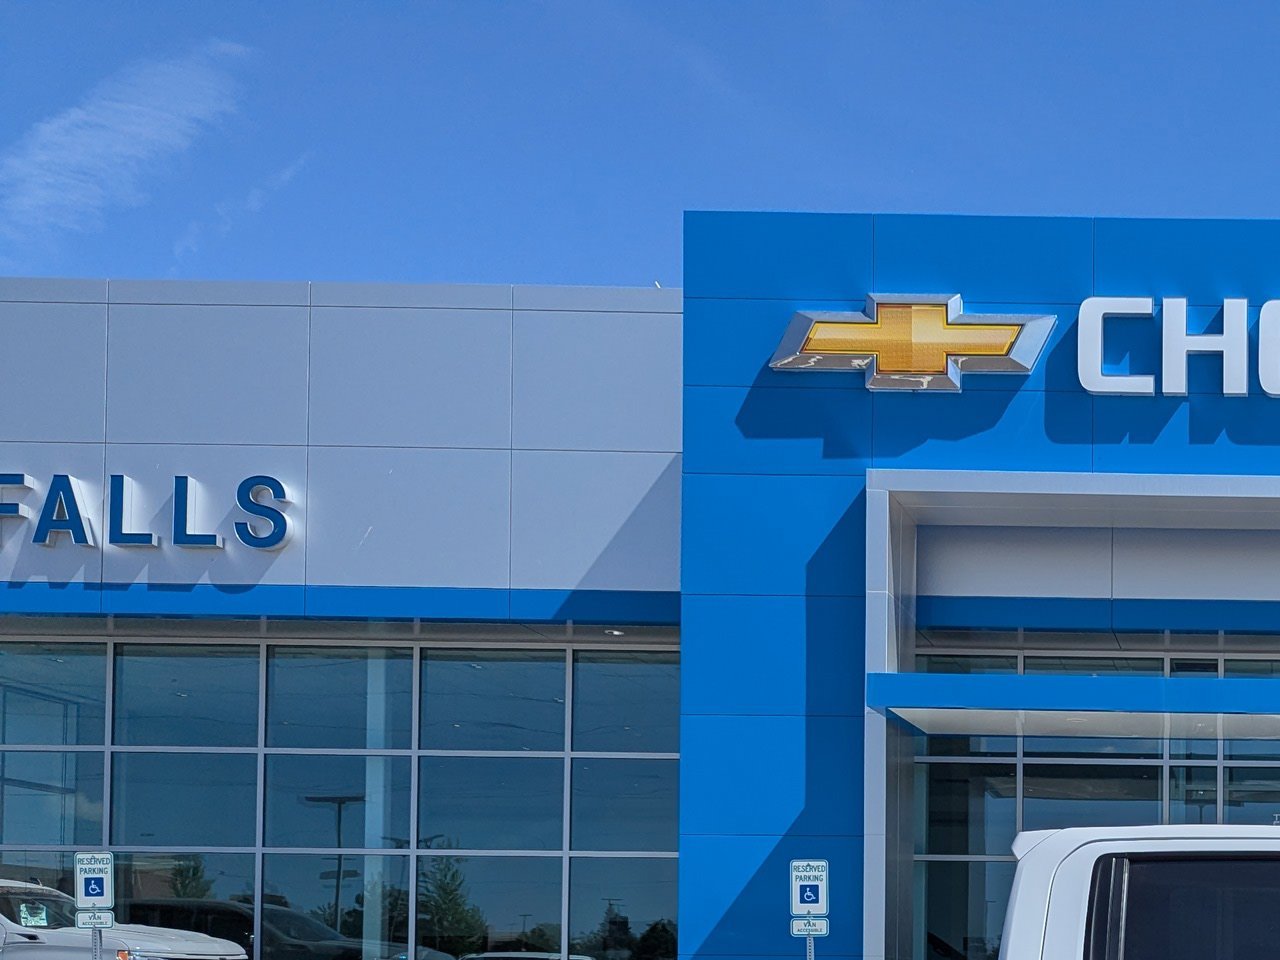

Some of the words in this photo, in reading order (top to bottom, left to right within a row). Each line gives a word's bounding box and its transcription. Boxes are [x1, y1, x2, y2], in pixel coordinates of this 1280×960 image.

[77, 857, 111, 865] RESERVED
[80, 867, 109, 875] PARKING
[793, 865, 826, 873] RESERVED
